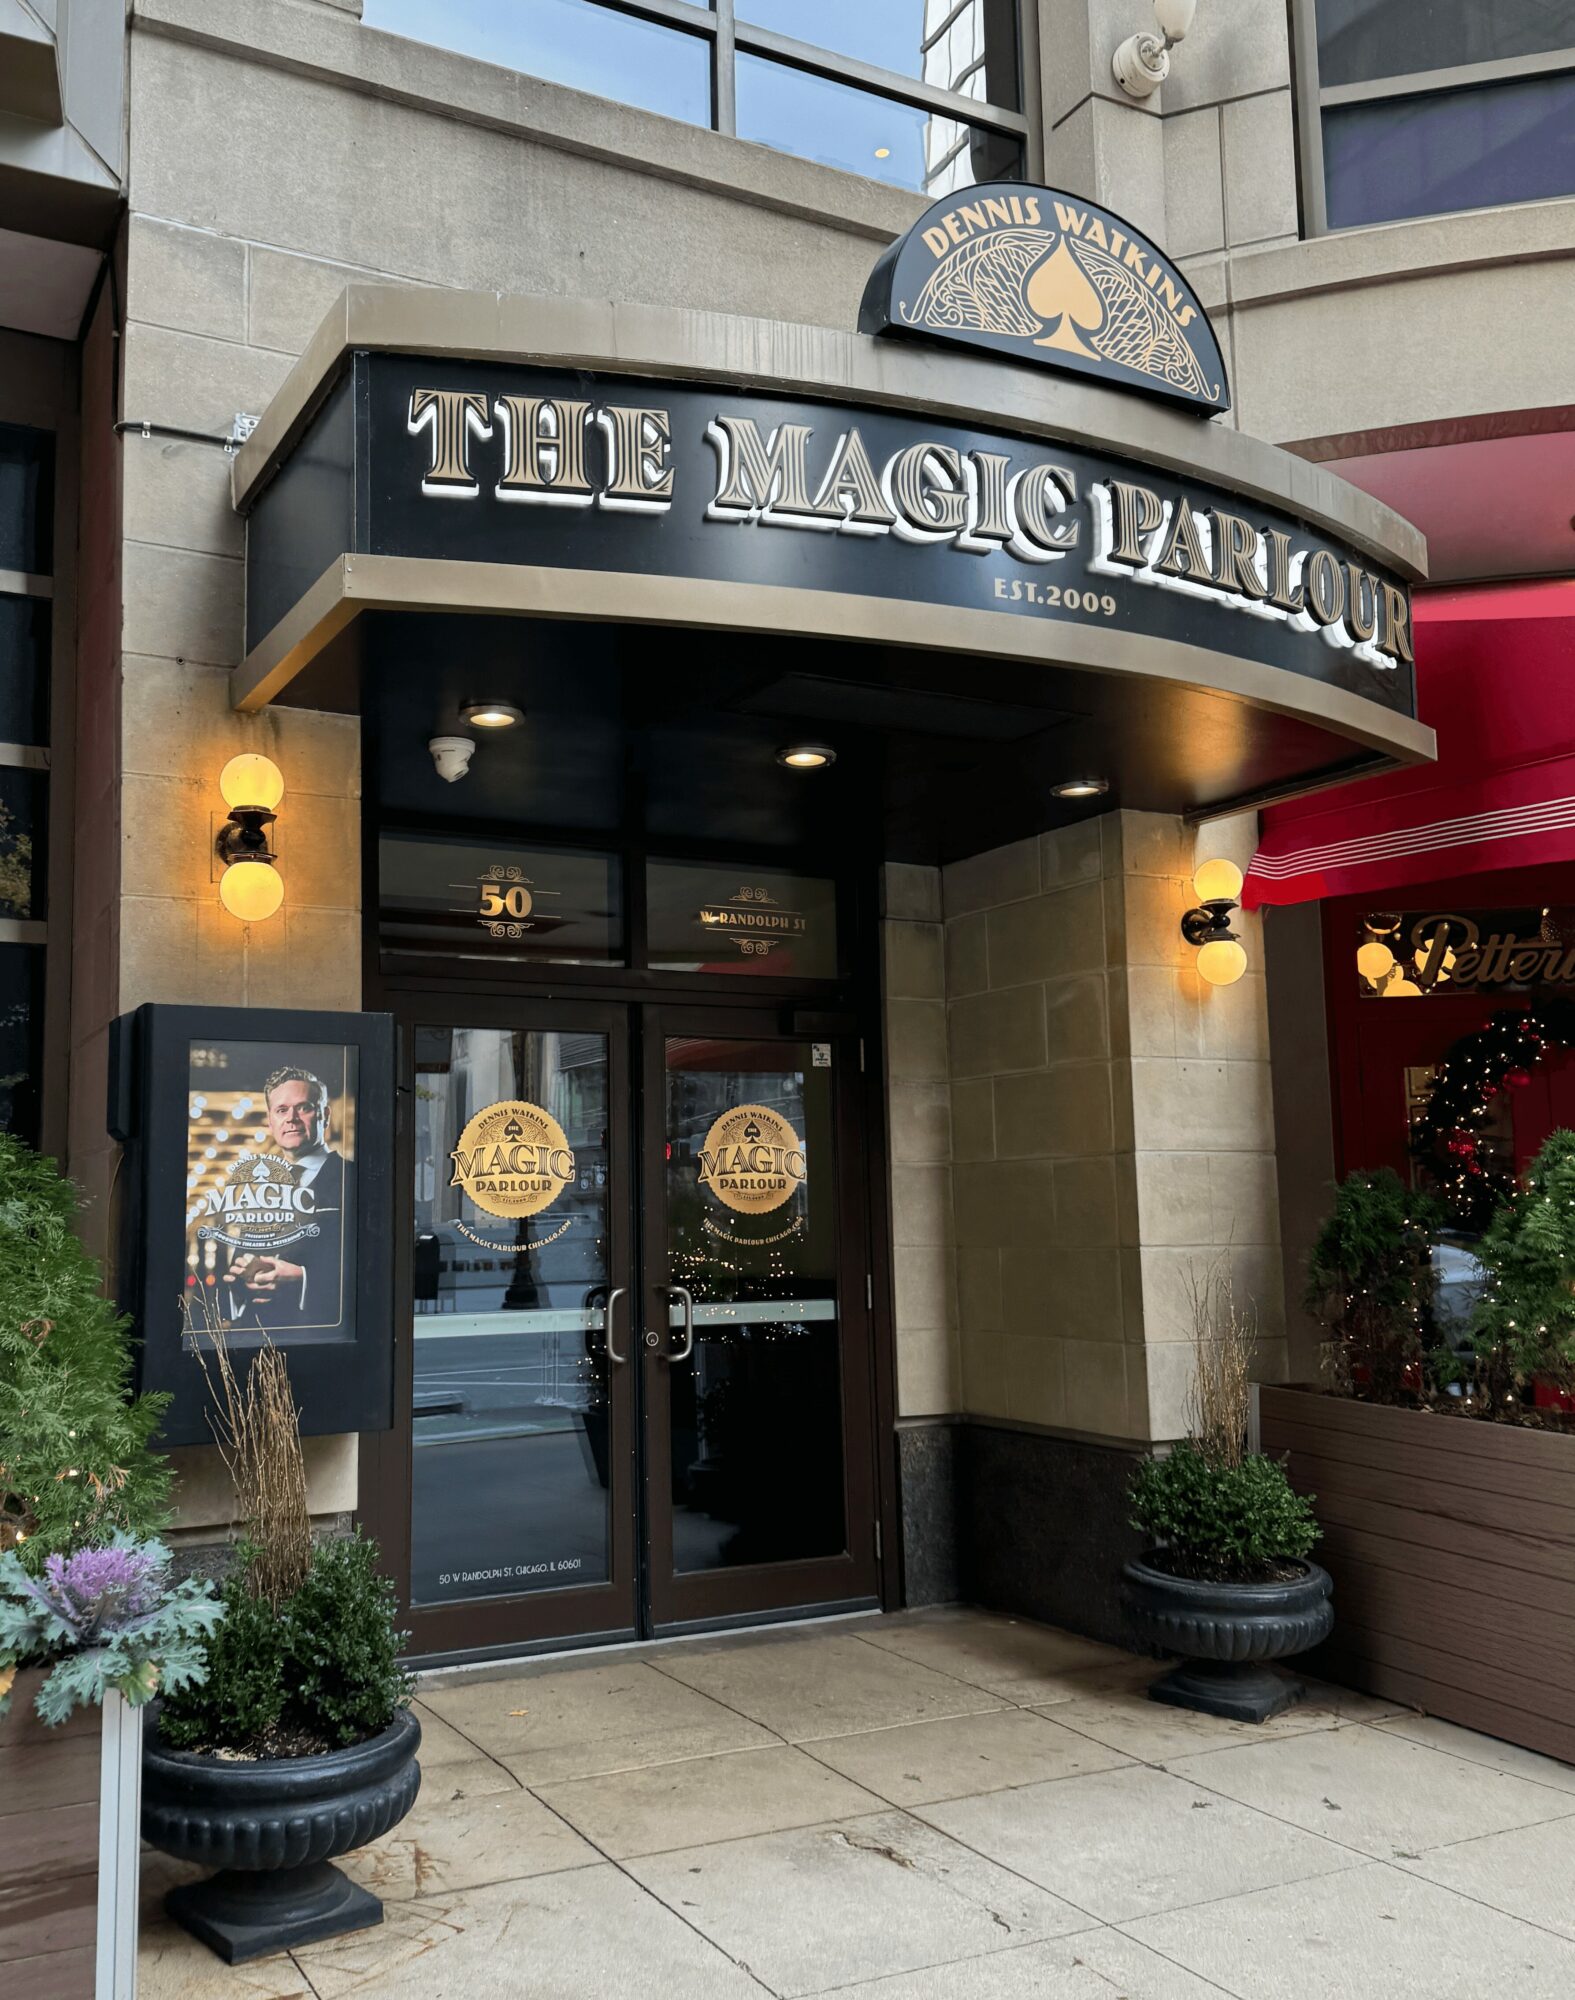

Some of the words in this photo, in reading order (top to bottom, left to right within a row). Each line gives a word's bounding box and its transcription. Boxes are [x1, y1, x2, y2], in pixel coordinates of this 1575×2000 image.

[921, 196, 1041, 259] DENNIS
[1054, 201, 1198, 328] WATKINS
[408, 387, 676, 511] THE
[707, 413, 1081, 560] MAGIC
[1091, 477, 1413, 669] PARLOUR
[995, 578, 1117, 616] EST.2009
[479, 885, 533, 918] 50
[720, 912, 789, 929] RANDOLPH
[478, 1109, 508, 1130] DENNIS
[511, 1108, 549, 1130] WATKINS
[721, 1112, 748, 1131] DENNIS
[750, 1111, 783, 1131] WATKINS
[230, 1154, 257, 1171] DENNIS
[259, 1154, 293, 1171] WATKINS
[452, 1145, 575, 1184] MAGIC
[699, 1145, 807, 1182] MAGIC
[475, 1180, 552, 1192] PARLOUR
[720, 1178, 787, 1189] PARLOUR
[204, 1183, 315, 1216] MAGIC
[225, 1212, 295, 1223] PARLOUR
[456, 1222, 469, 1237] THE
[470, 1233, 491, 1249] MAGIC
[492, 1243, 527, 1252] PARLOUR
[715, 1228, 733, 1242] MAGIC
[734, 1236, 764, 1245] PARLOUR
[439, 1574, 450, 1585] 50
[453, 1572, 461, 1583] W
[462, 1568, 502, 1582] RANDOLPH
[550, 1562, 556, 1571] IL
[557, 1558, 581, 1571] 60601
